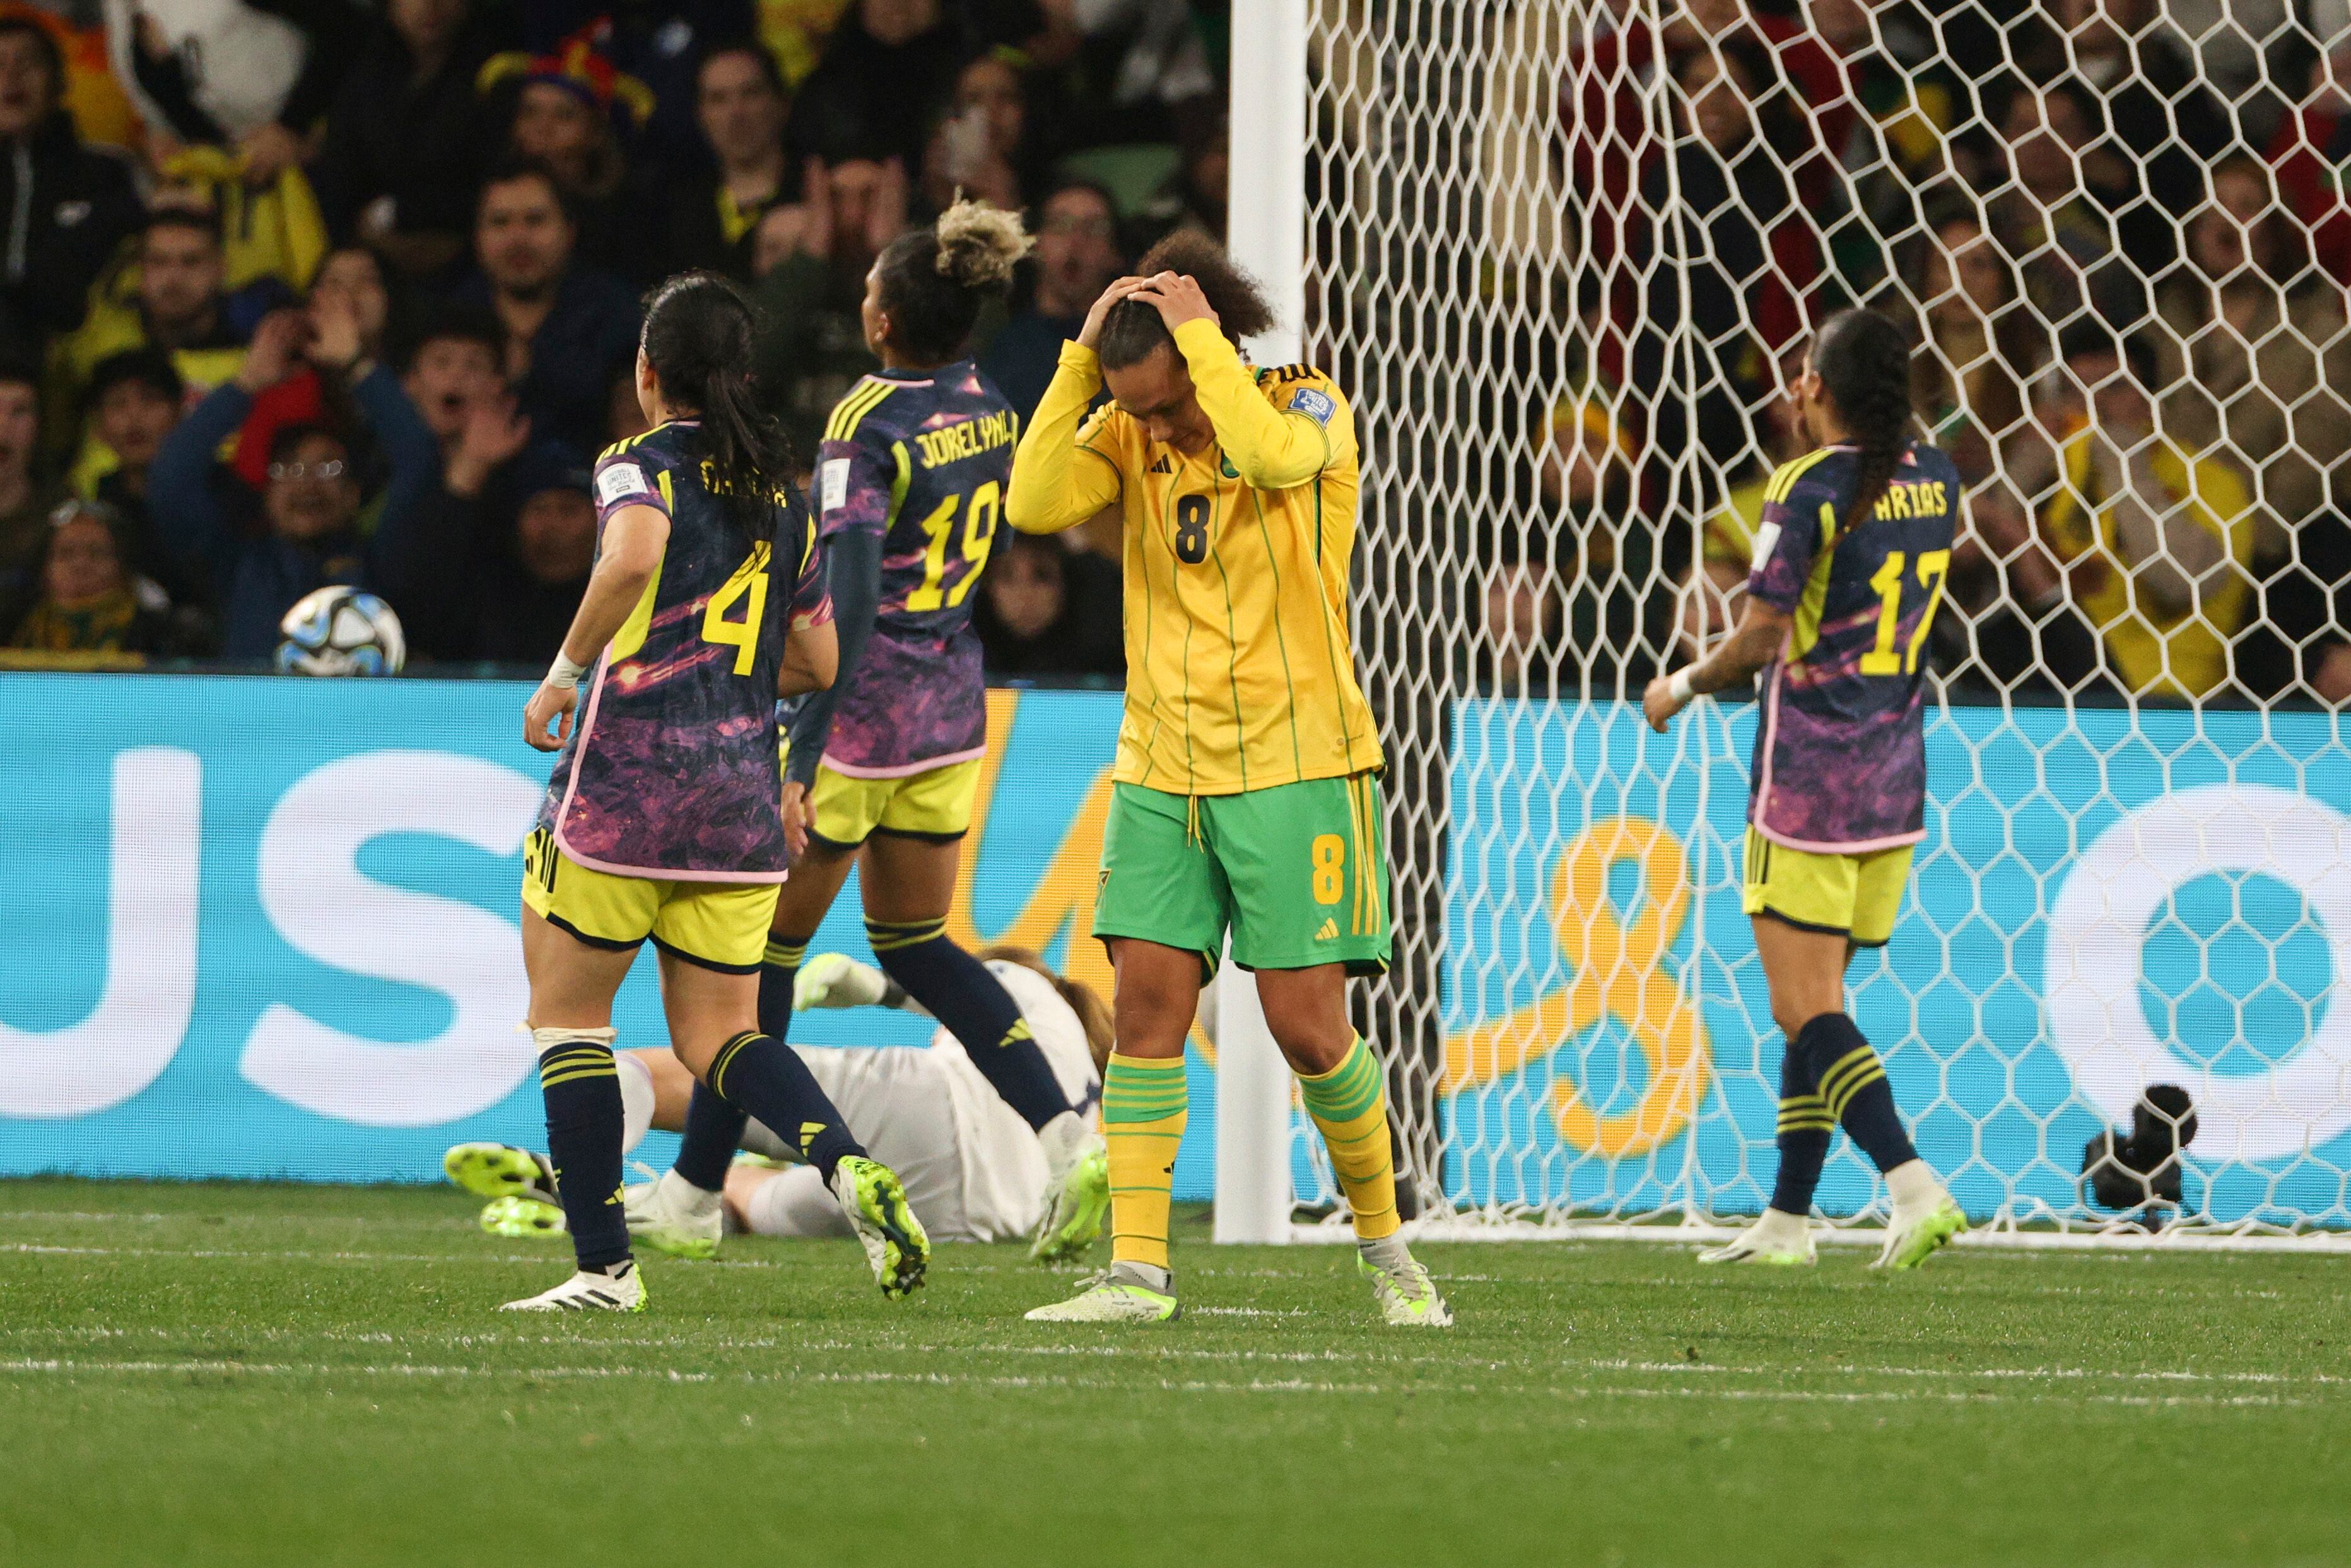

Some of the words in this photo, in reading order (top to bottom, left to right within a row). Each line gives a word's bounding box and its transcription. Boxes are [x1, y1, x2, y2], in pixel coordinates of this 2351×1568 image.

[905, 481, 999, 612] 19
[1175, 494, 1211, 564] 8
[701, 540, 771, 676] 4
[1860, 548, 1951, 676] 17
[1312, 834, 1344, 905] 8
